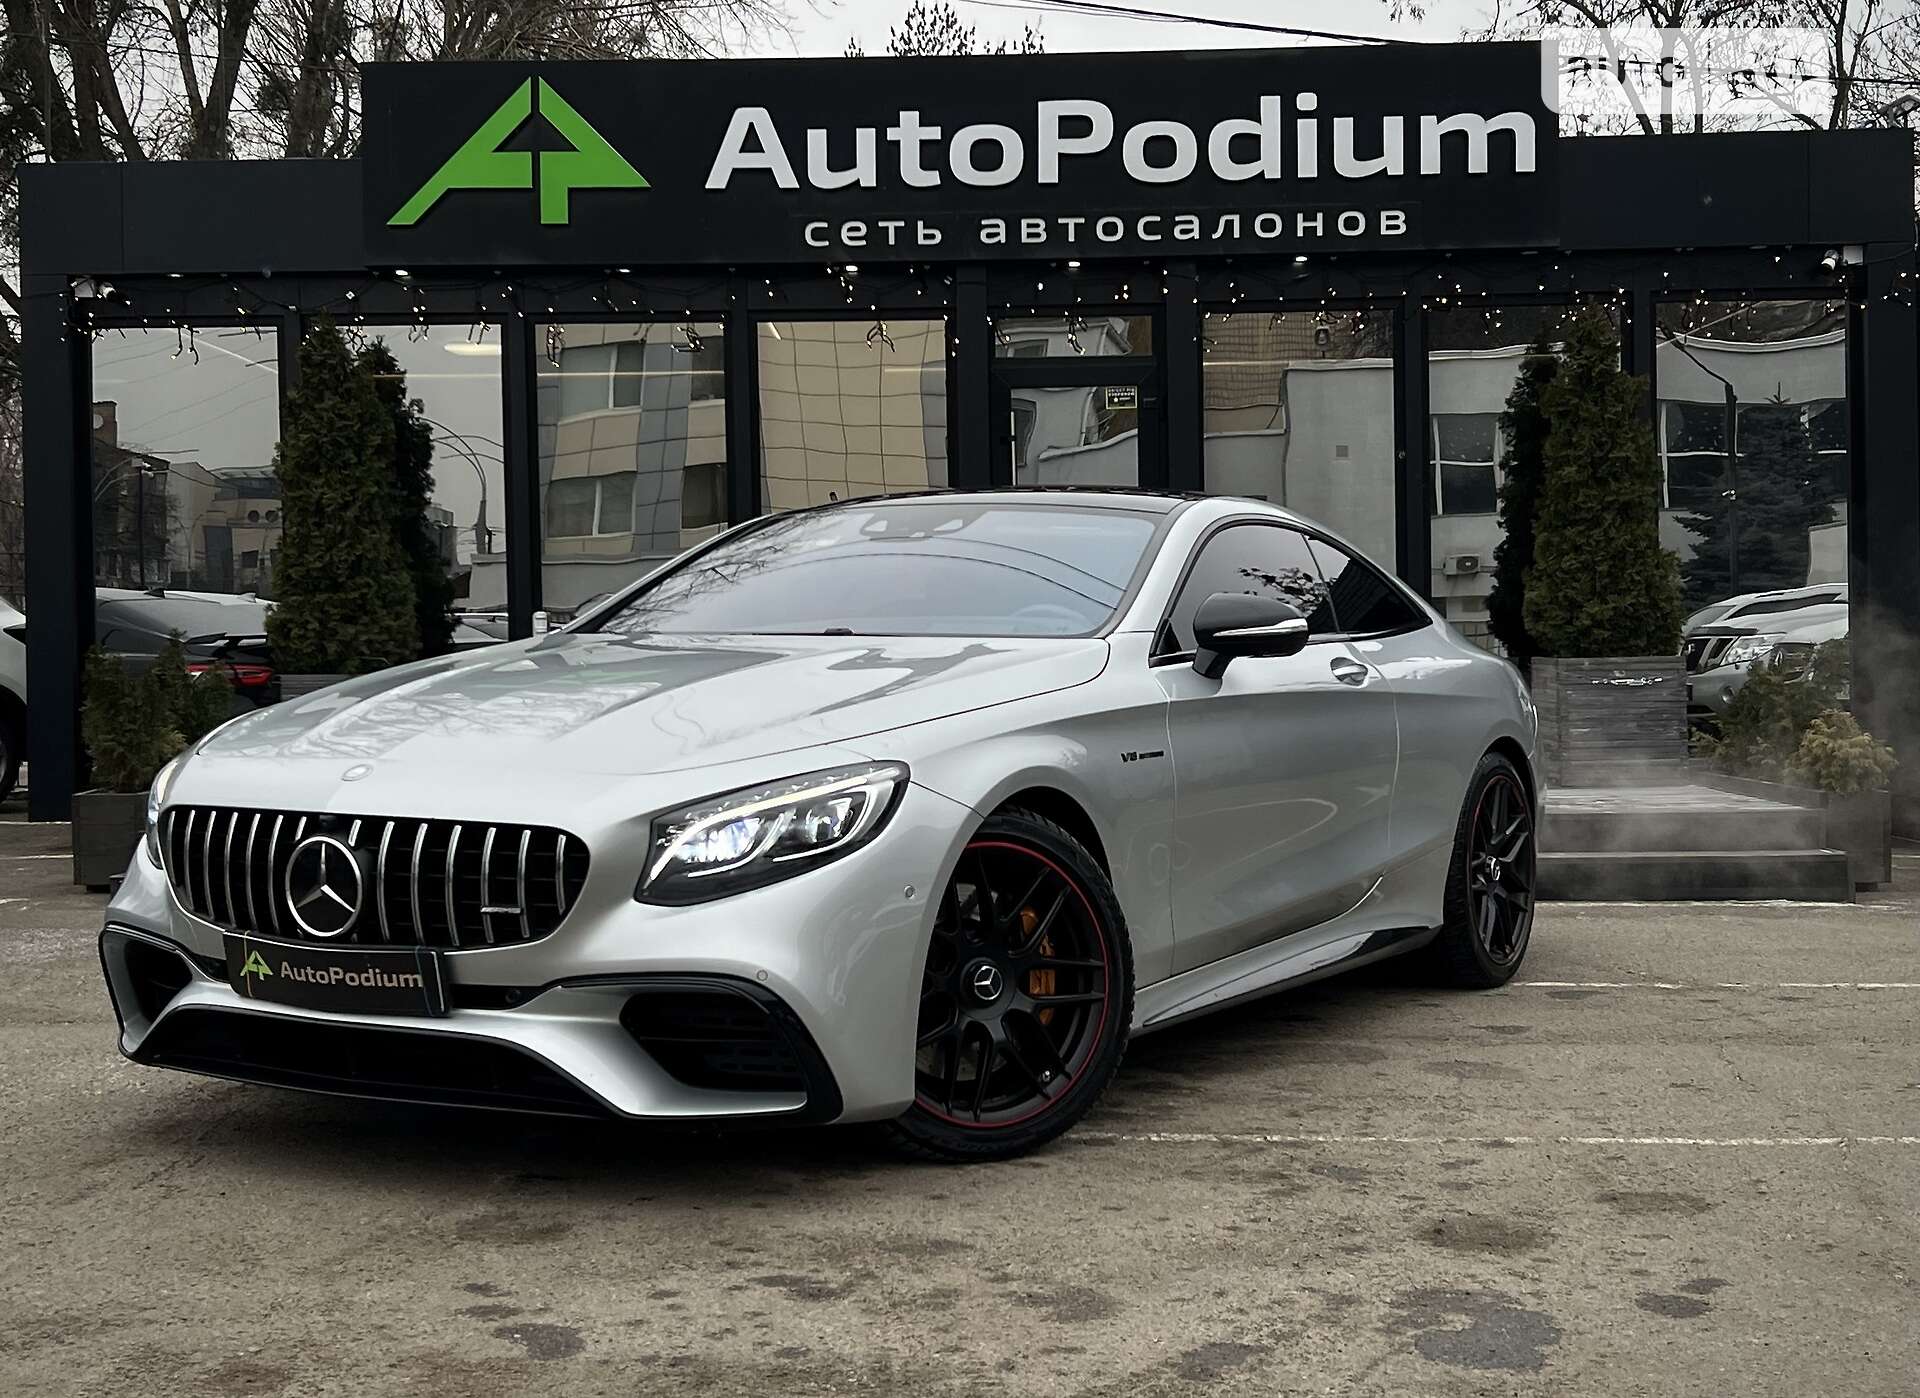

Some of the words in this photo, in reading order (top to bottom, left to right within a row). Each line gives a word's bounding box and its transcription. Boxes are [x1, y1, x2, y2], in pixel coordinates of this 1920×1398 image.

[705, 93, 1535, 189] AutoPodium
[805, 221, 941, 246] сеть
[980, 211, 1406, 243] автосалонов
[281, 962, 423, 987] AutoPodium
